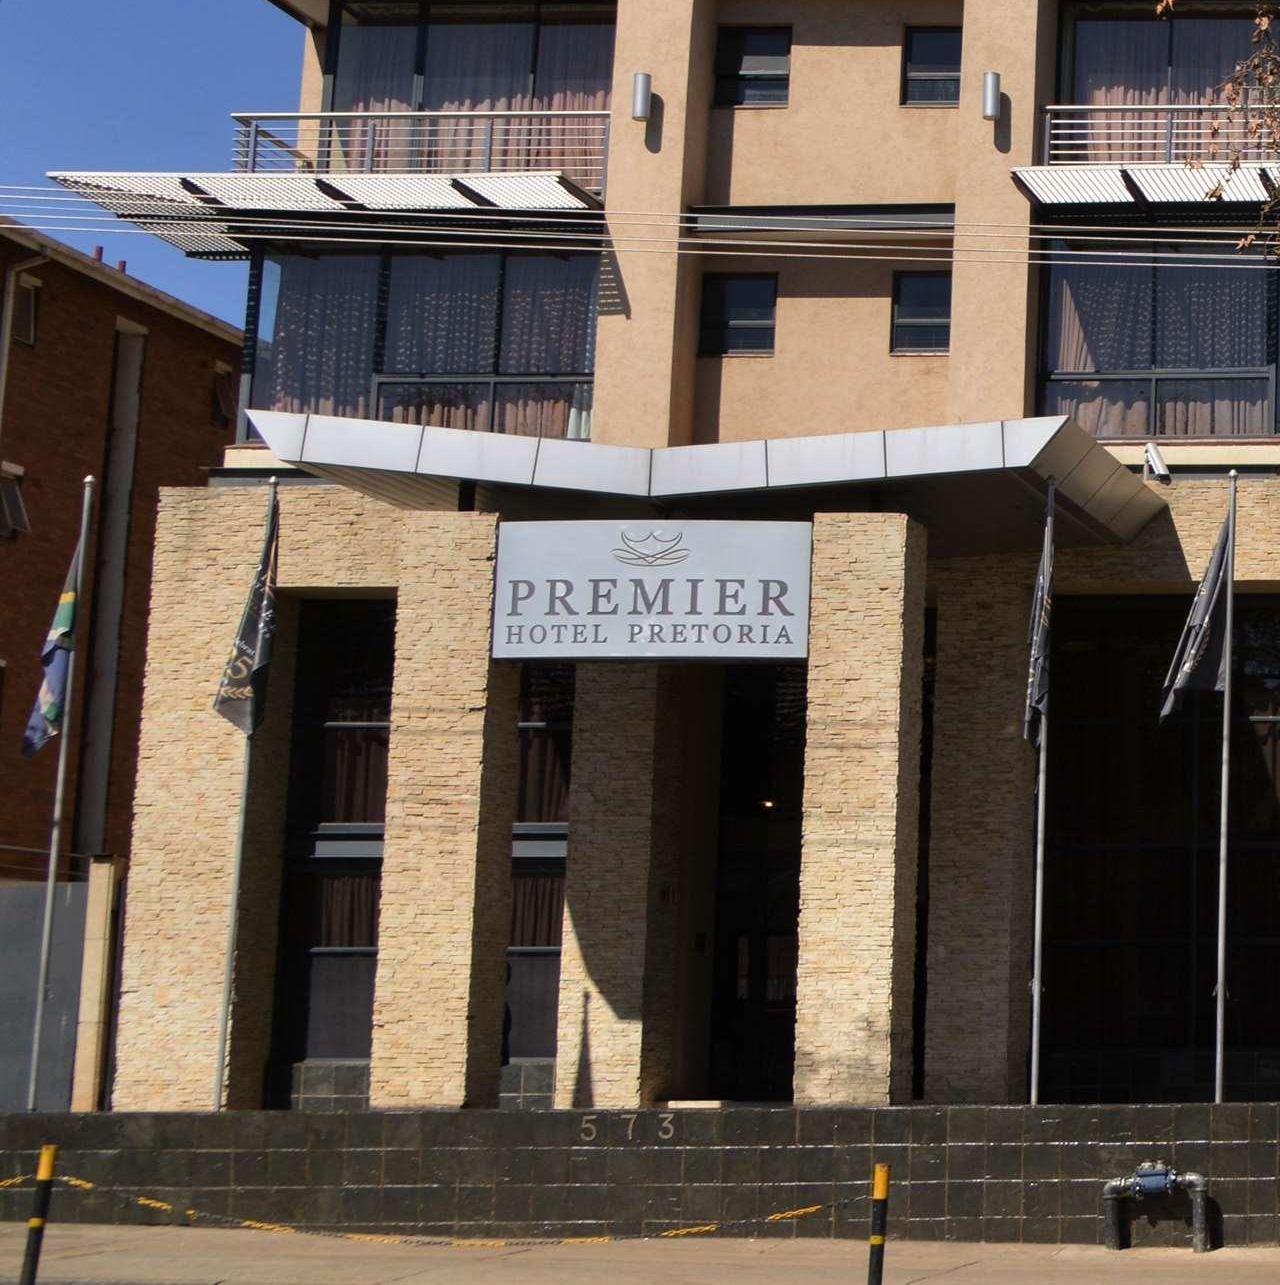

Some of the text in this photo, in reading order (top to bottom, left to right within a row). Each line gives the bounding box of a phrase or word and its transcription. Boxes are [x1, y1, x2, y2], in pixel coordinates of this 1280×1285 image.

[506, 578, 796, 617] PREMIER
[505, 623, 795, 645] HOTEL PRETORIA
[580, 1113, 675, 1142] 573
